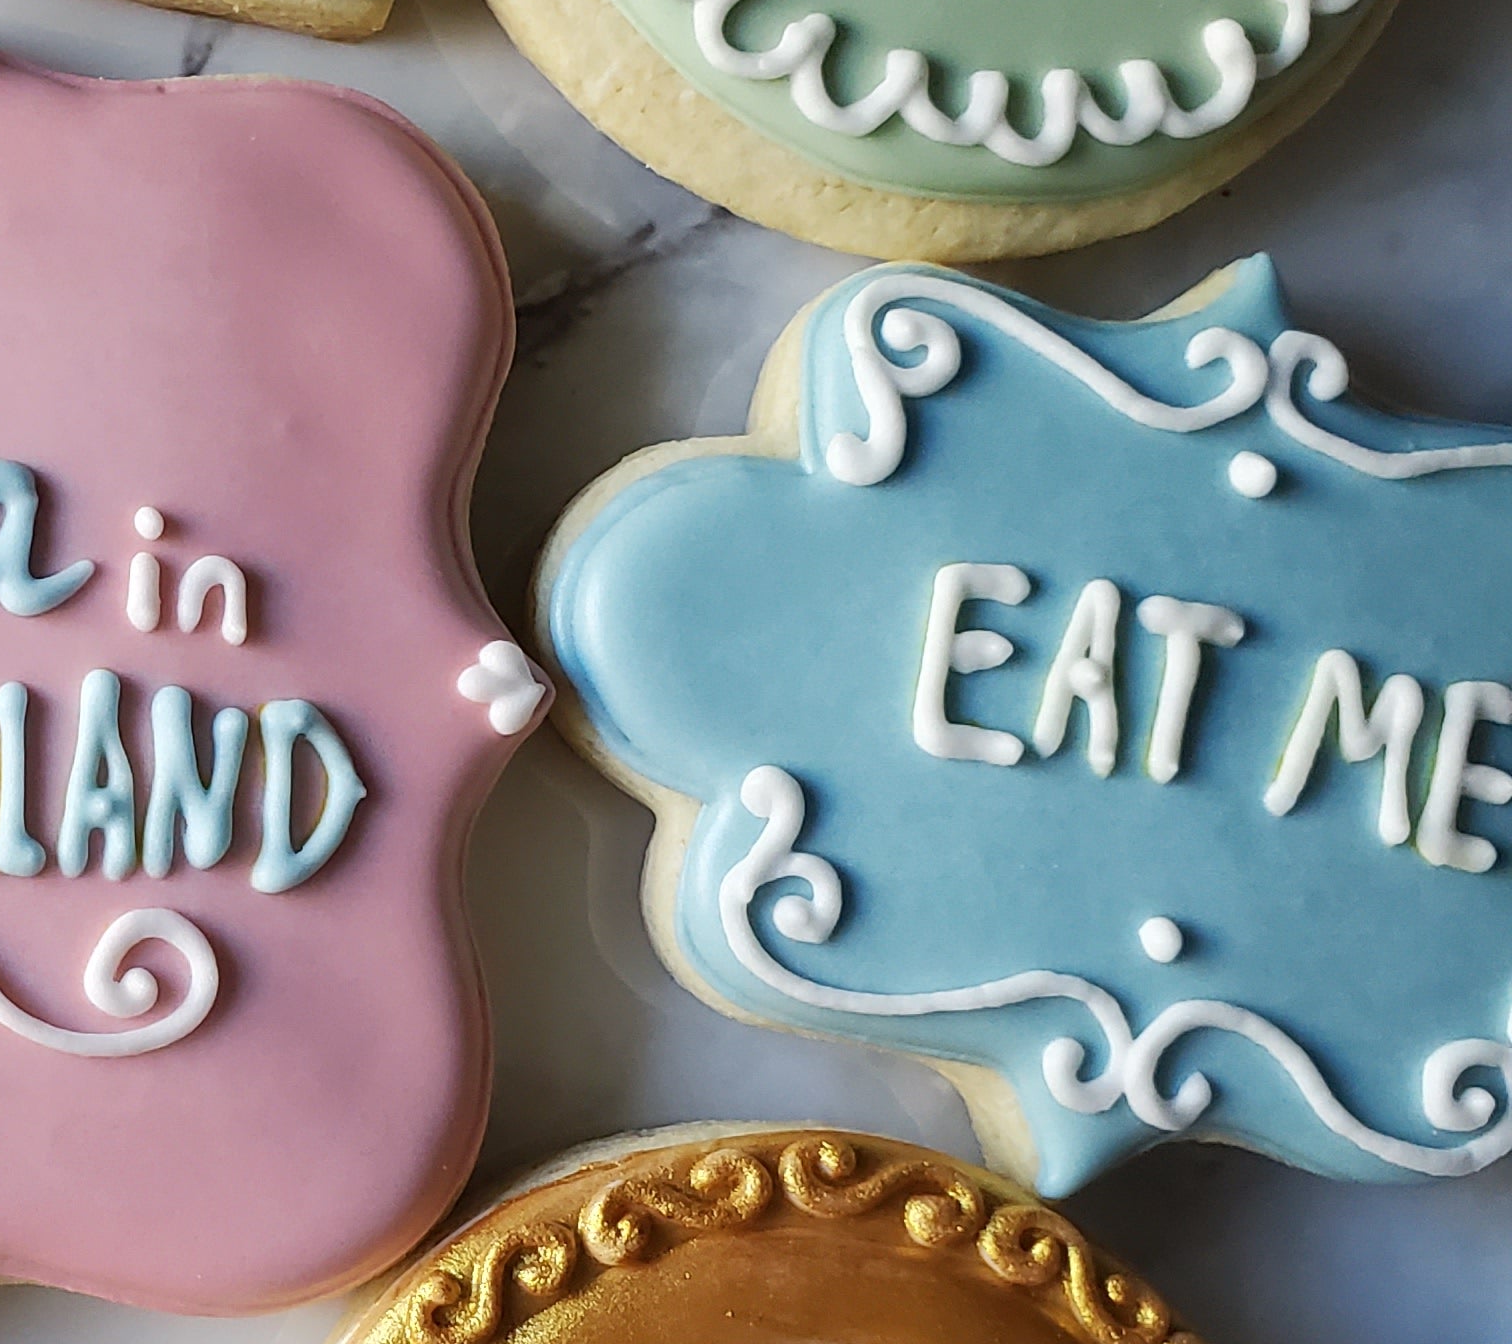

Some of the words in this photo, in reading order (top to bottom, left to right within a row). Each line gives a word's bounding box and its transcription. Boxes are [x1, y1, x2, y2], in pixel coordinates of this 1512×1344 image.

[126, 504, 247, 647] in
[913, 562, 1245, 784] EAT
[1263, 649, 1512, 873] ME
